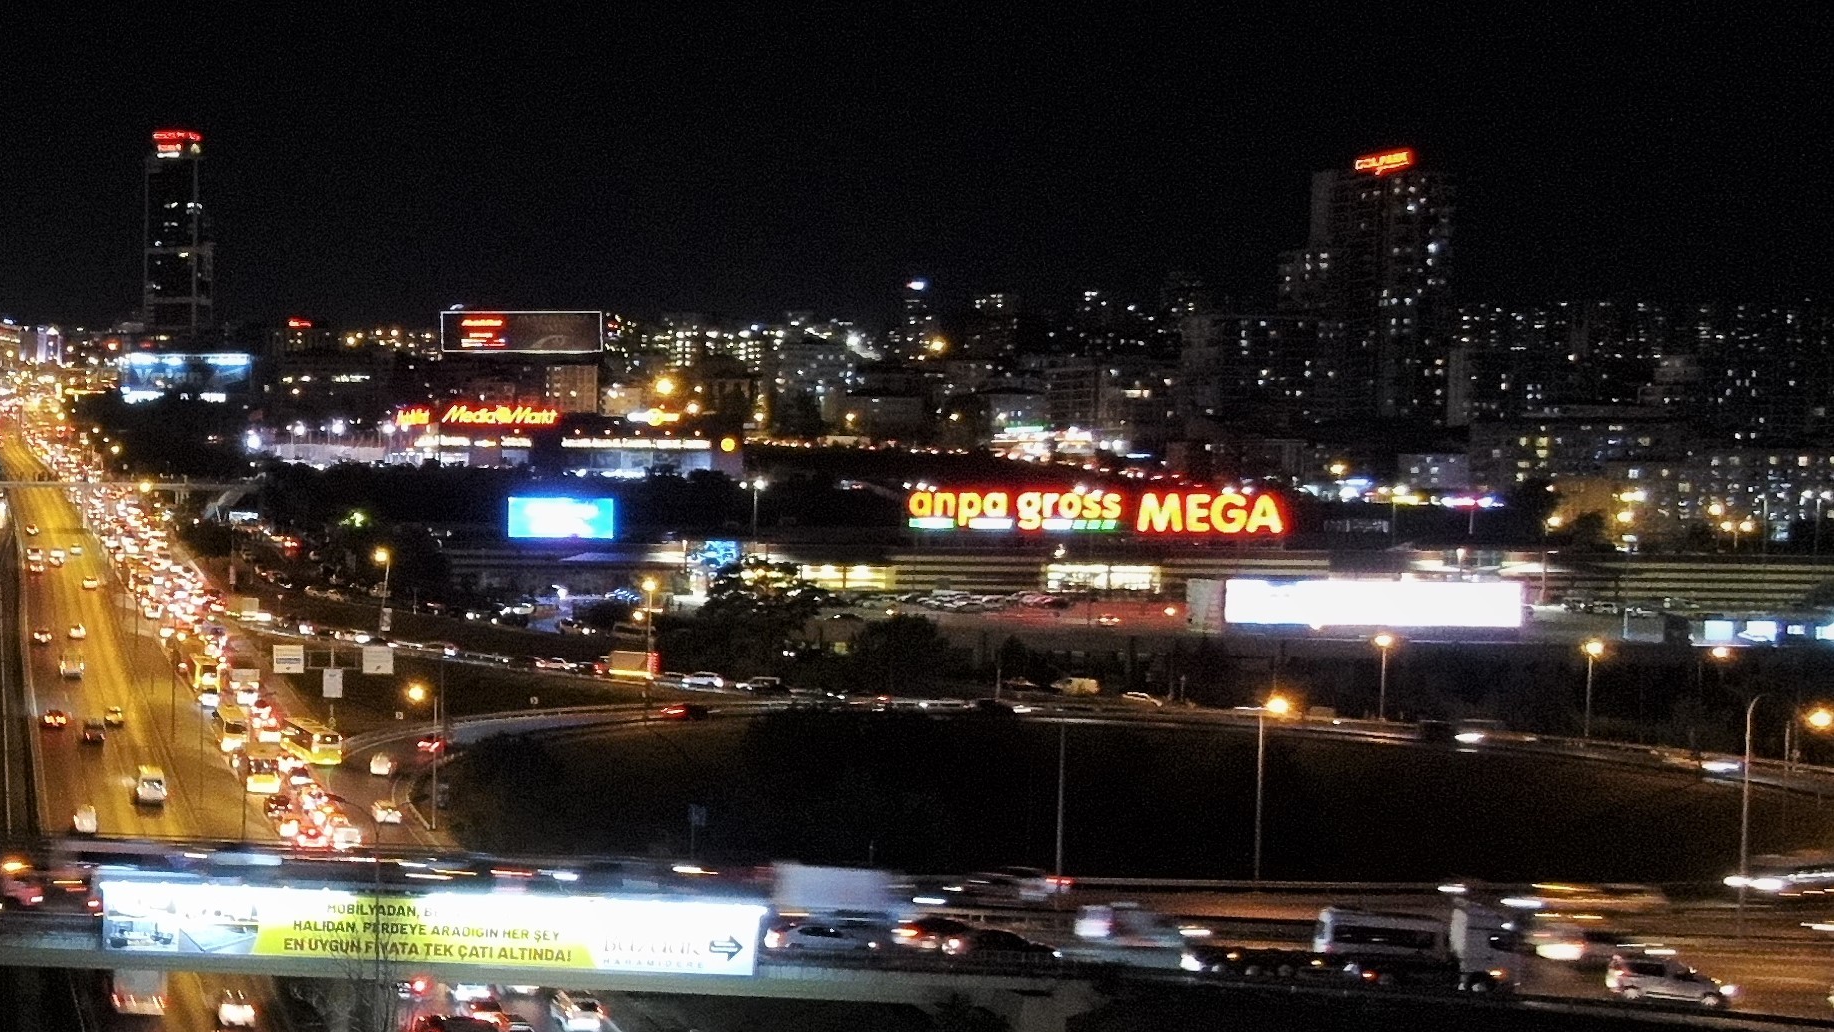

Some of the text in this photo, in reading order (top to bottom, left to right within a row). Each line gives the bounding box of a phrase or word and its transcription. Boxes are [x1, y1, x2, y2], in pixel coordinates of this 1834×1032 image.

[908, 492, 1285, 534] anpa gross MEGA
[502, 928, 530, 940] HER
[534, 930, 560, 943] ŞEY
[284, 937, 305, 951] EN
[308, 938, 362, 954] UYGUN
[424, 943, 454, 957] TEK
[457, 944, 494, 961] ÇATI
[497, 947, 572, 962] ALTINDA!
